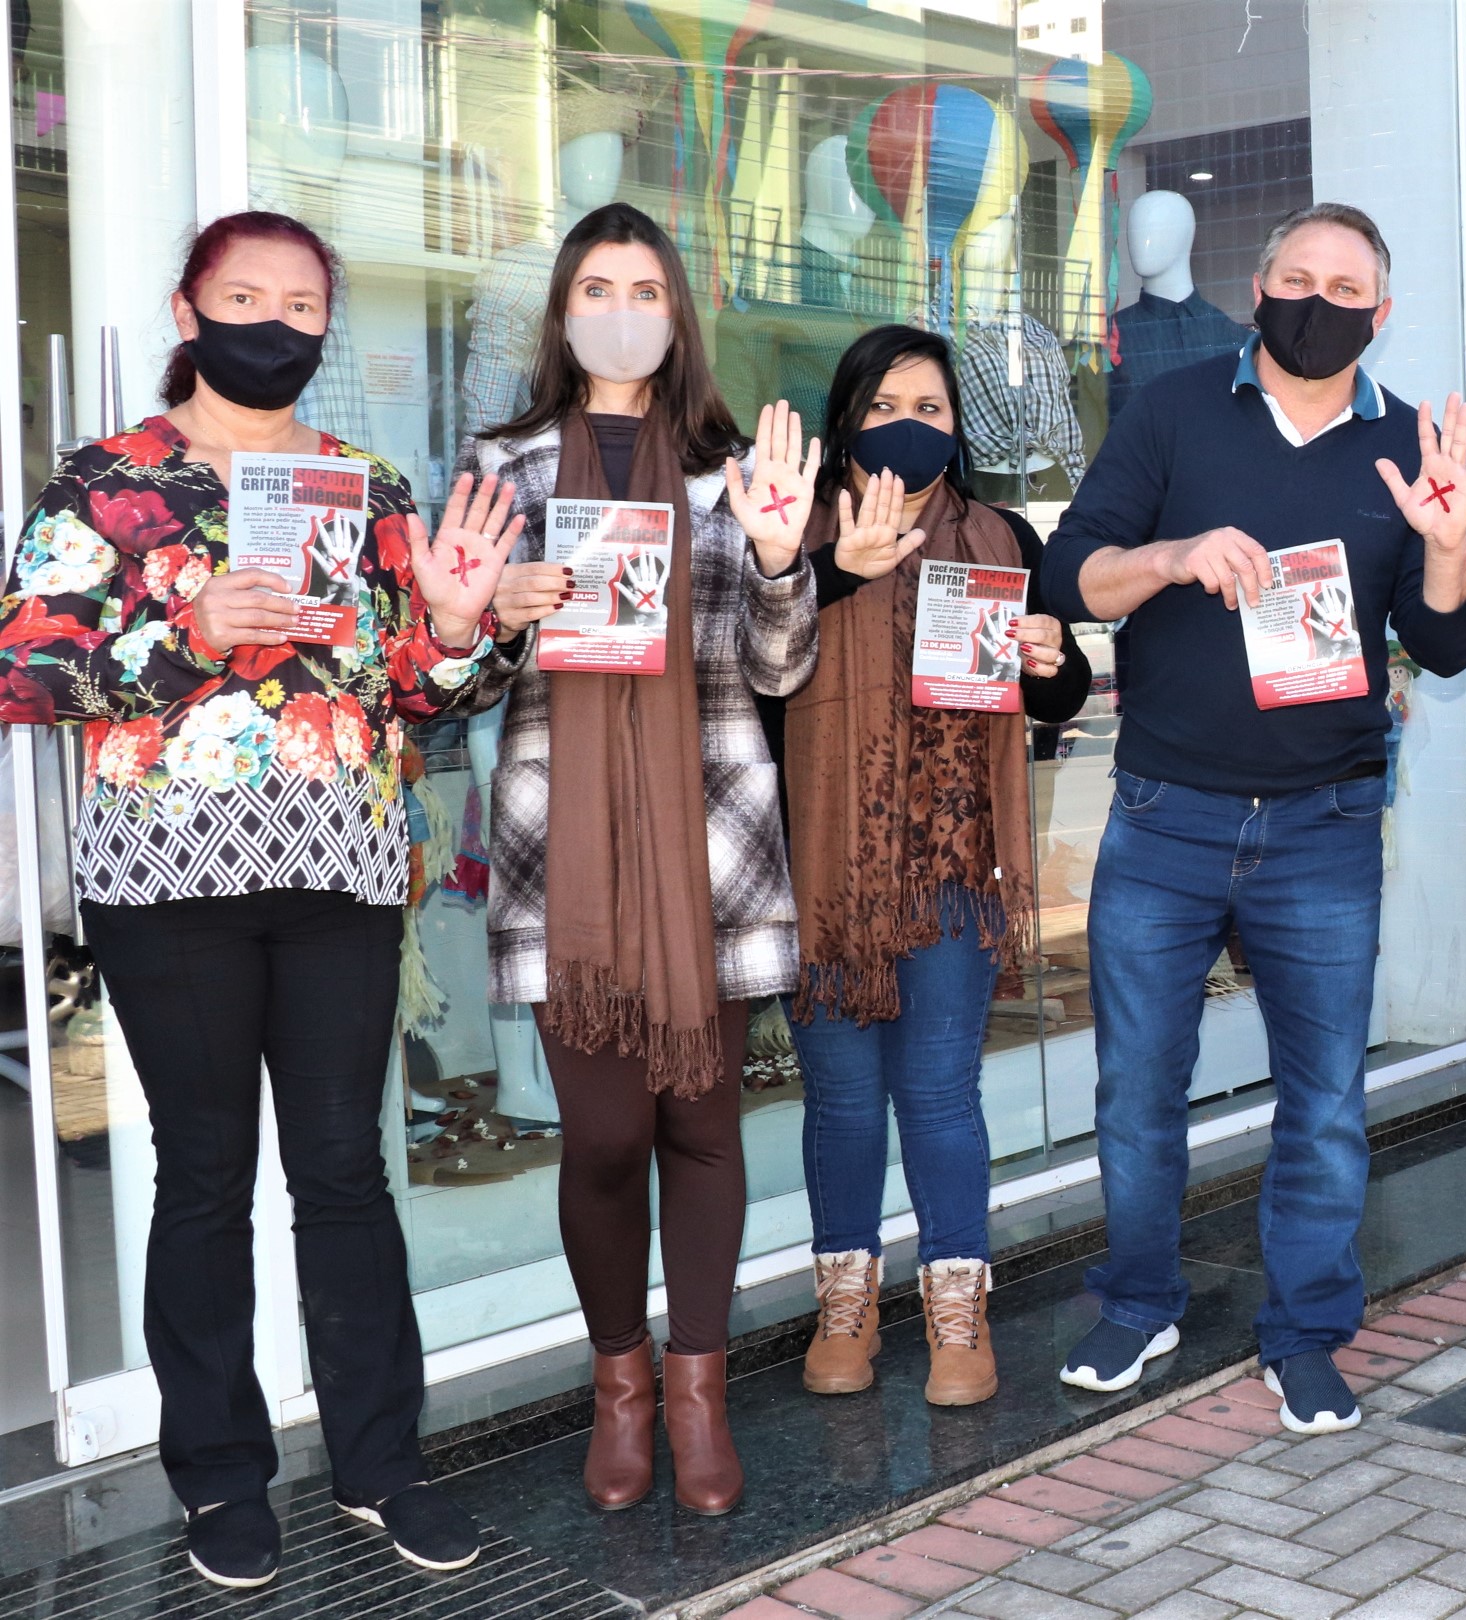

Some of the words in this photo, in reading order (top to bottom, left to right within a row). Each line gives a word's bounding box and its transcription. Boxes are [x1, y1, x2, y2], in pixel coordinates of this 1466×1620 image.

[242, 466, 265, 476] VOCÊ
[268, 468, 291, 476] PODE
[241, 478, 289, 491] GRITAR
[267, 494, 289, 504] POR
[557, 504, 578, 514] VOCÊ
[580, 506, 600, 515] PODE
[556, 516, 598, 530] GRITAR
[929, 564, 948, 572] VOCÊ
[949, 566, 968, 574] PODE
[928, 574, 965, 586] GRITAR
[946, 588, 964, 598] POR
